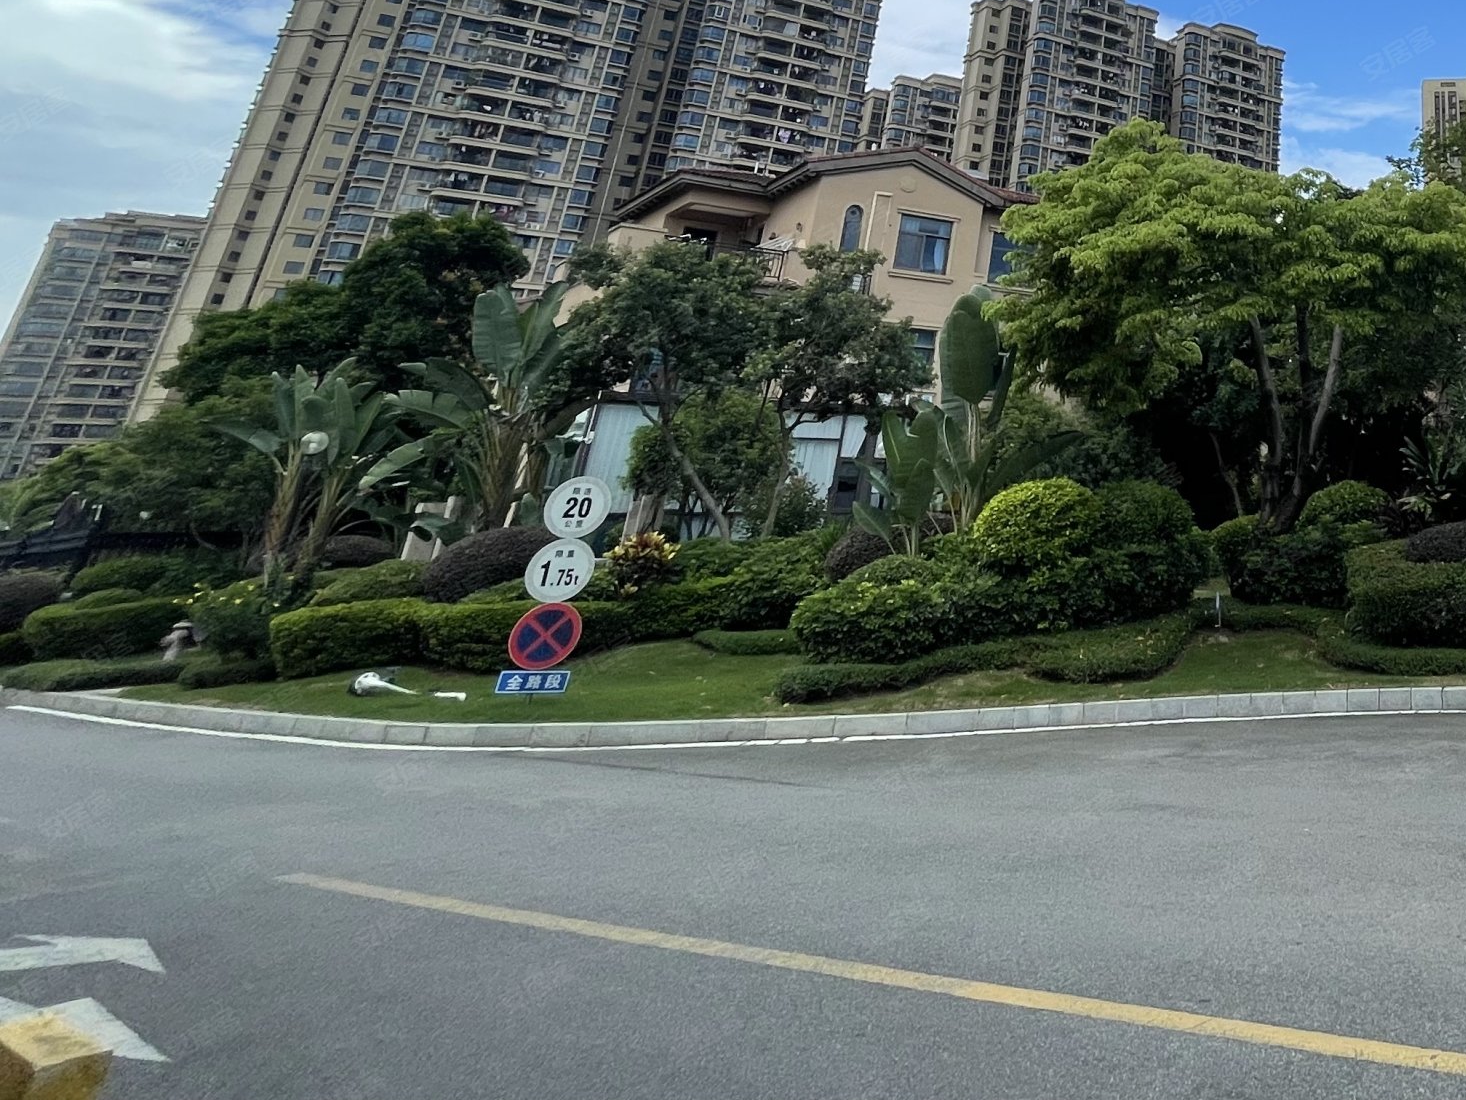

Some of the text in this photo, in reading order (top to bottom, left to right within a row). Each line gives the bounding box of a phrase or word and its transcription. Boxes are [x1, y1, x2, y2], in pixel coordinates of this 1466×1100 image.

[562, 497, 593, 519] 20
[540, 560, 579, 587] 1.75t
[505, 674, 562, 690] 全路段
